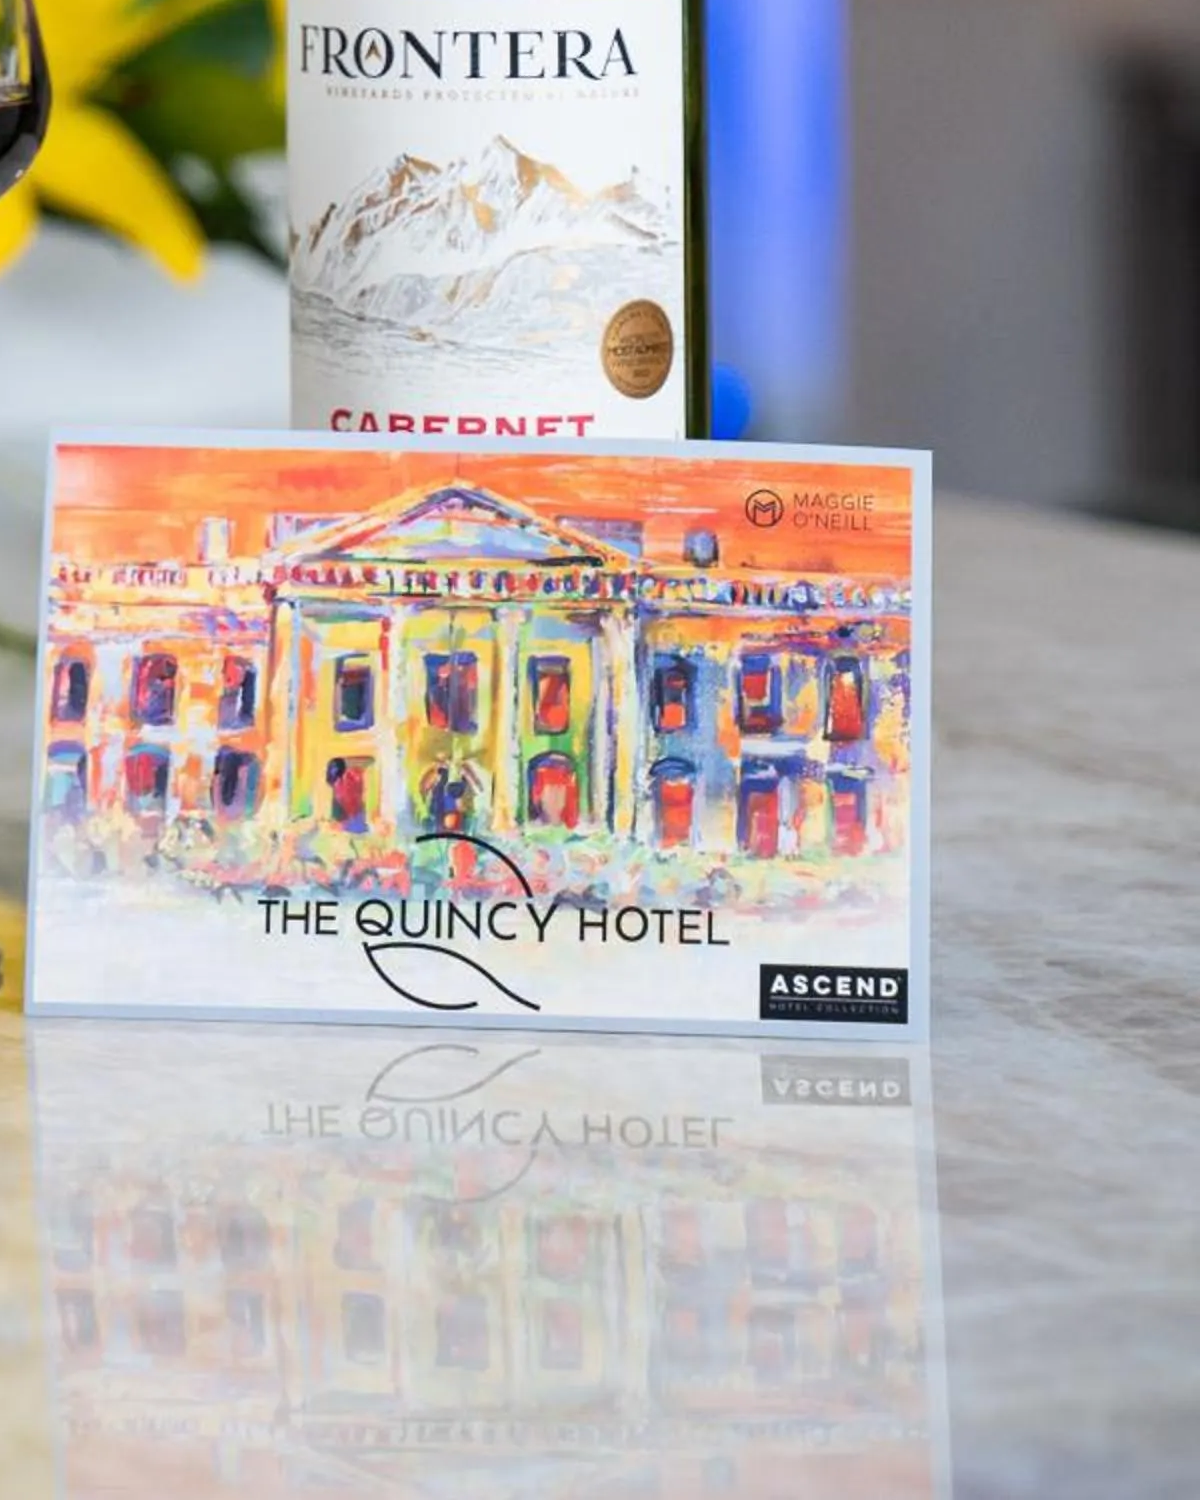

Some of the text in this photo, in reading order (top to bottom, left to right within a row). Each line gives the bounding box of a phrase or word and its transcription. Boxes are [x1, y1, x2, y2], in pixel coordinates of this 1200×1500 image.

[300, 24, 638, 81] FRONTERA
[793, 492, 875, 512] MAGGIE
[793, 512, 873, 532] O'NEILL
[257, 899, 731, 946] THE QUINCY HOTEL
[770, 973, 899, 998] ASCEND
